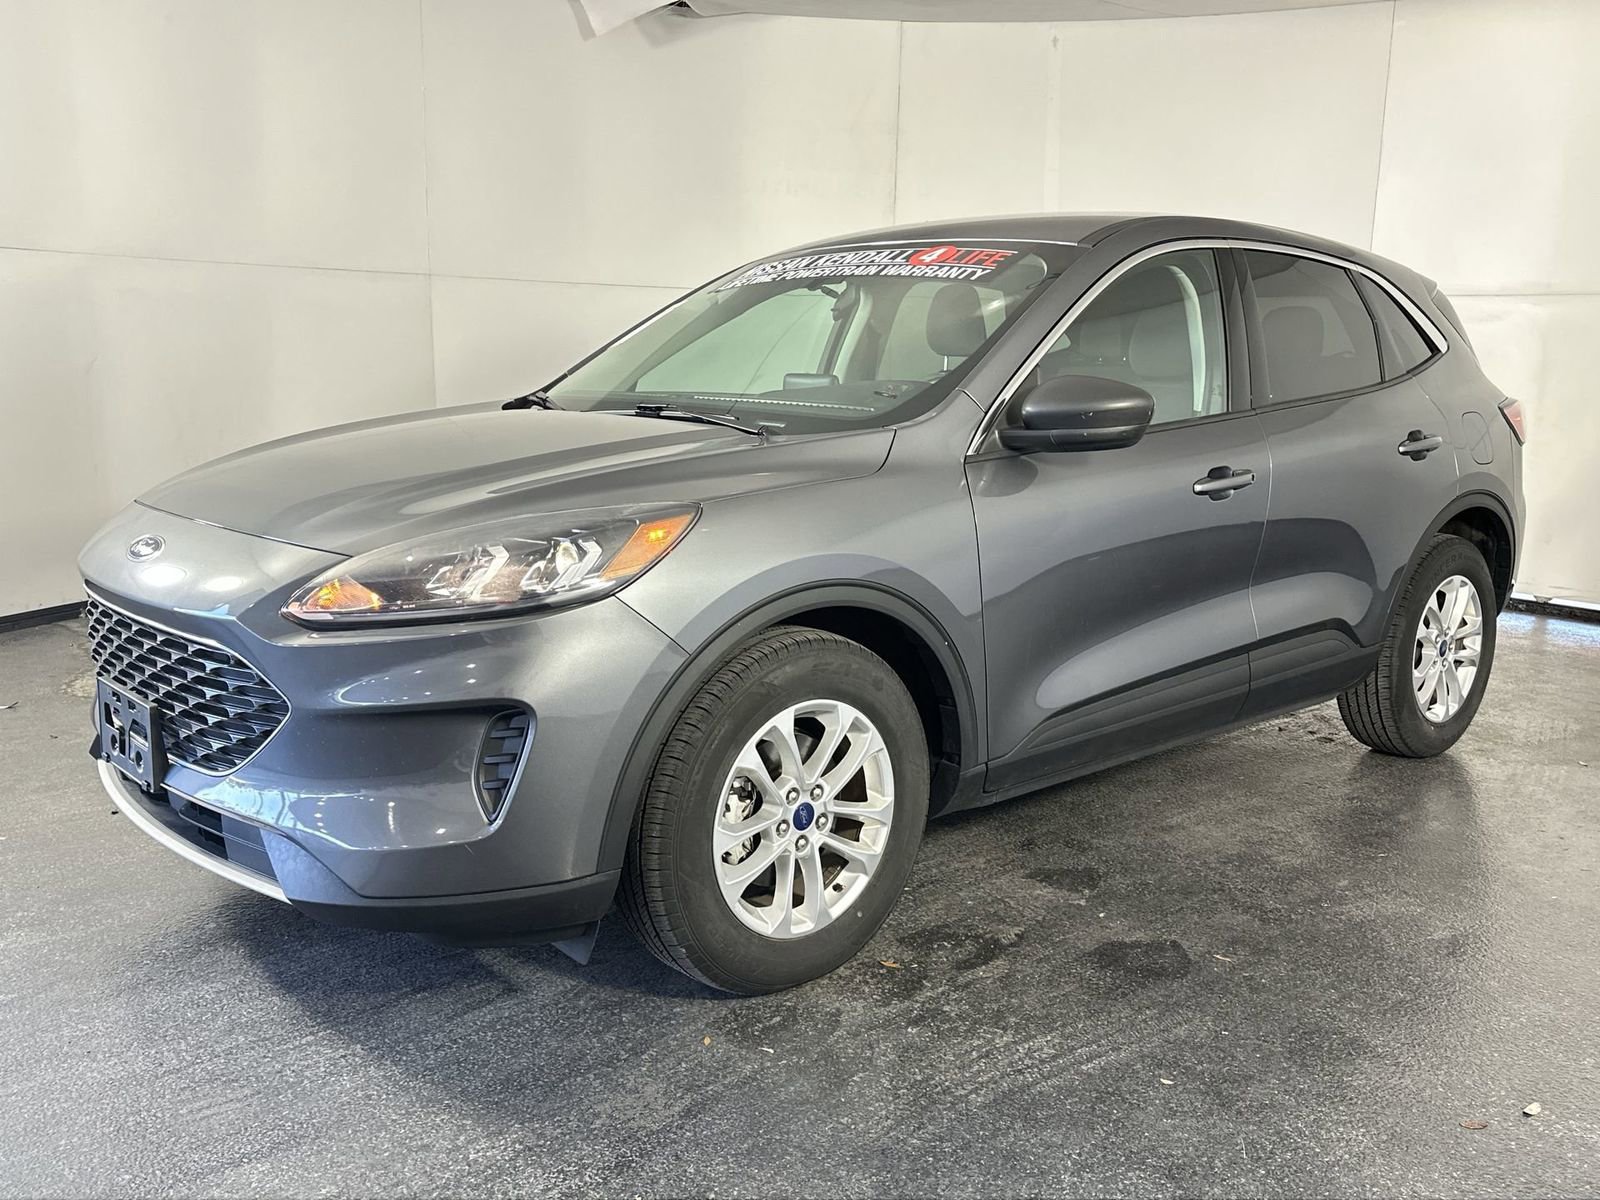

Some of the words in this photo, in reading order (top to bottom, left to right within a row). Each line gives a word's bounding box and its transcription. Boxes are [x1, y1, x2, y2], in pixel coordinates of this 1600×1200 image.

[809, 250, 914, 267] KENDALL
[919, 248, 948, 263] 4
[945, 249, 1013, 266] LIFE
[775, 264, 892, 281] POWERTRAIN
[881, 265, 993, 281] WARRANTY
